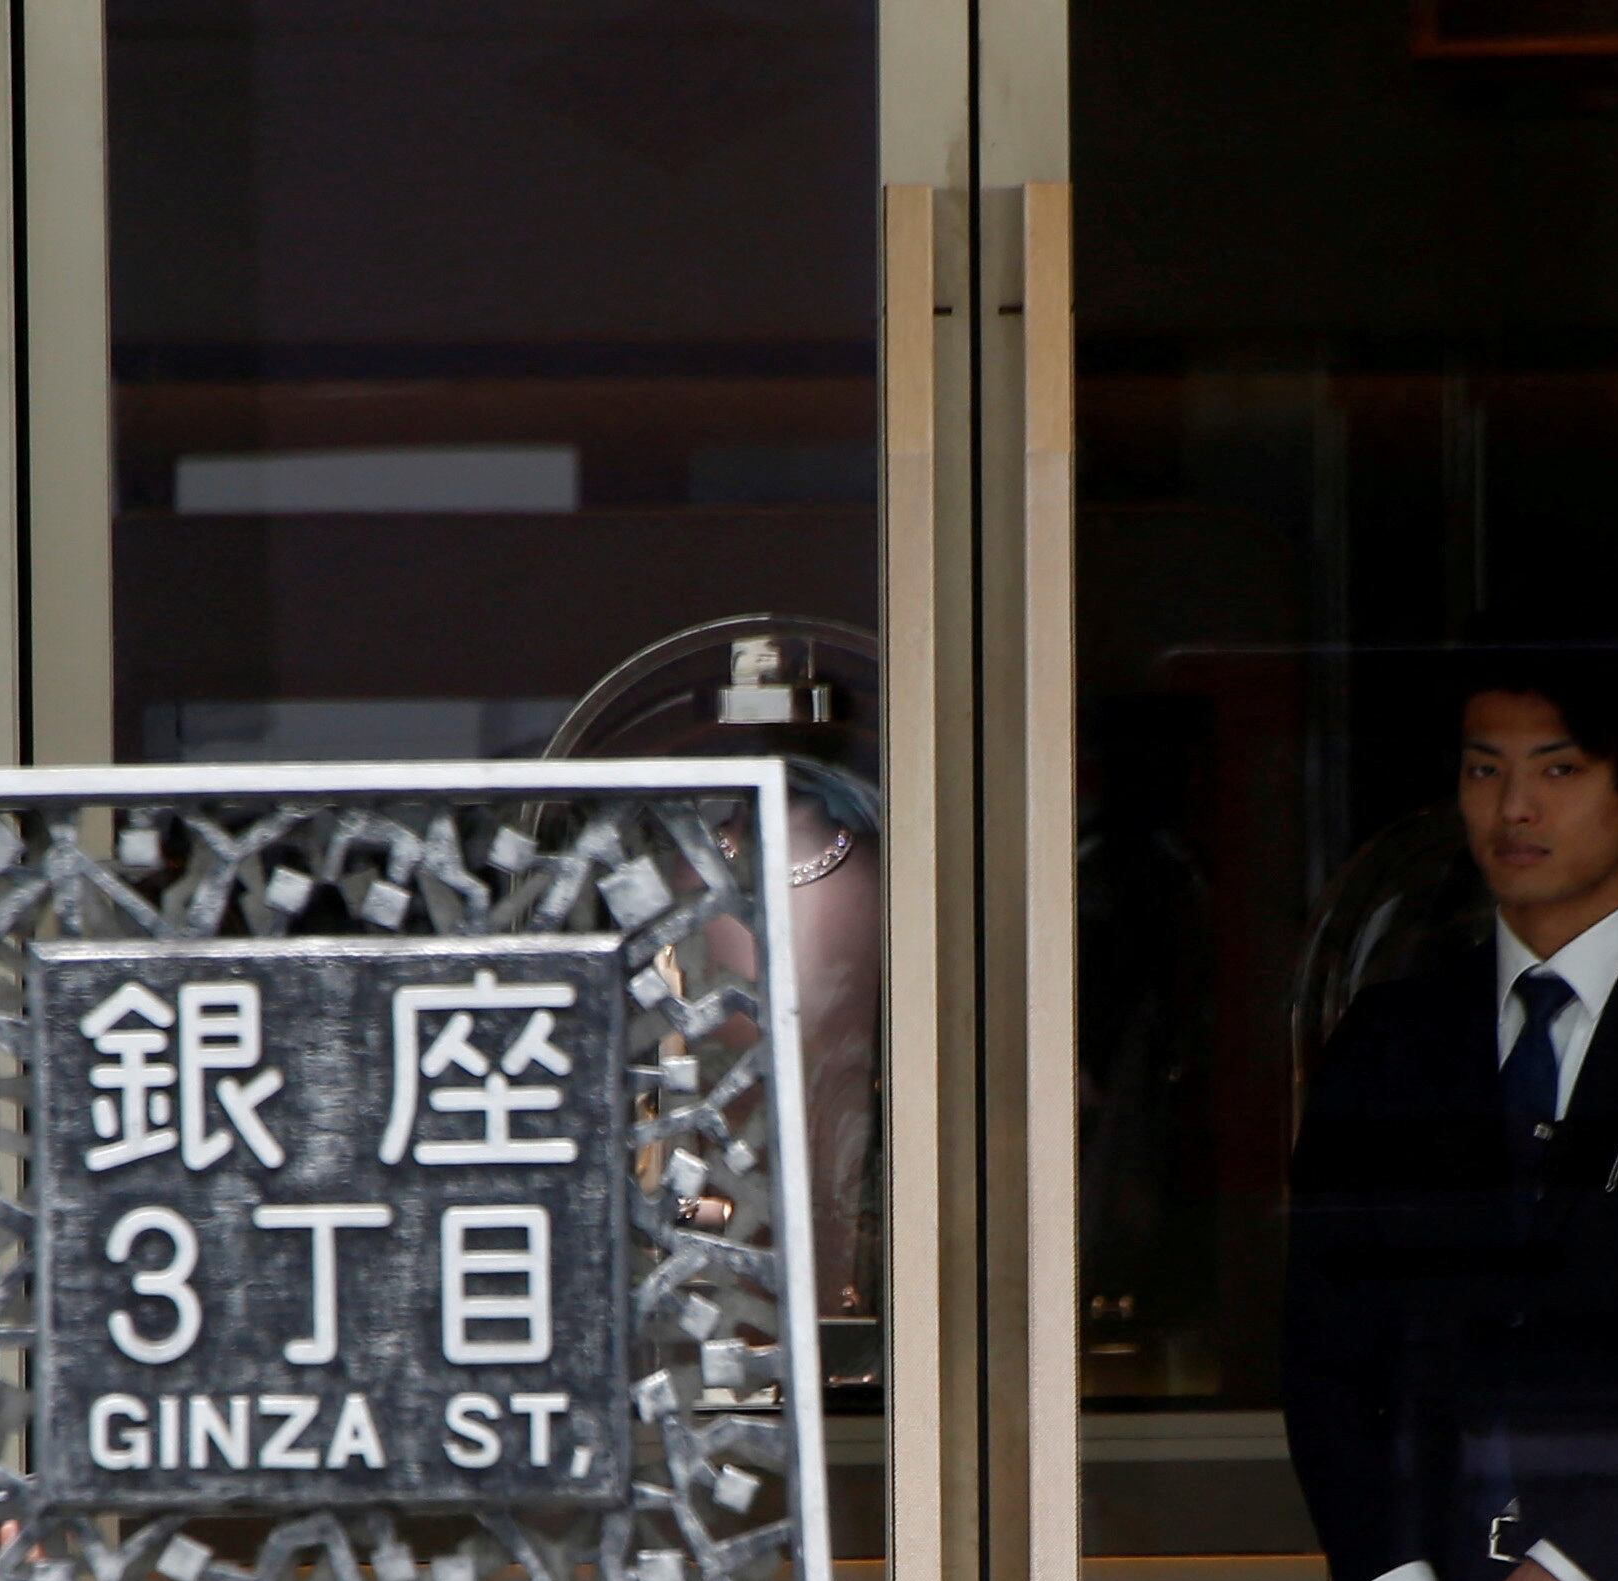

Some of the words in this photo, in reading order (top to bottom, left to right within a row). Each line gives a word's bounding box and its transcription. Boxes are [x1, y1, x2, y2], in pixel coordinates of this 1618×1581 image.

[79, 967, 580, 1173] 銀座
[104, 1202, 555, 1367] 3丁目
[87, 1391, 385, 1471] GINZA
